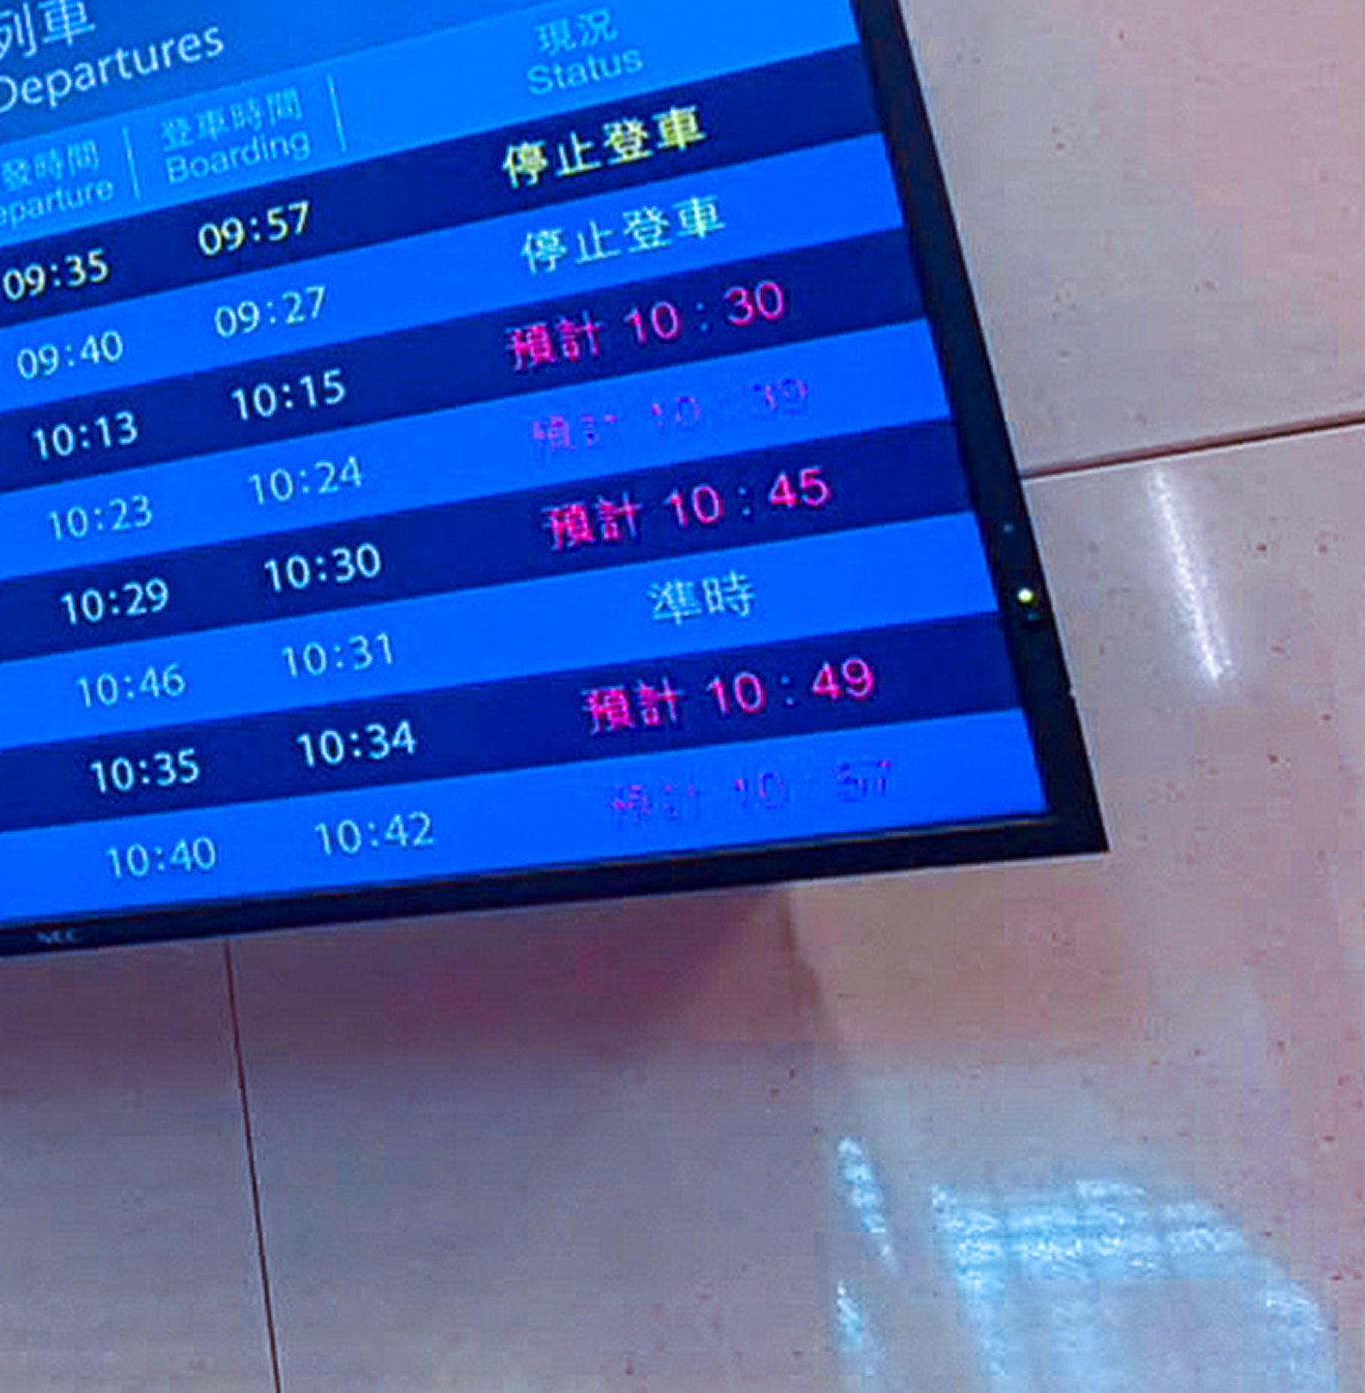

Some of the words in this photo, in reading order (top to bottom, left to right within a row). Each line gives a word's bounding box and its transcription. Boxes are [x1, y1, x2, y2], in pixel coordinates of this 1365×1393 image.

[536, 8, 617, 57] 現況
[526, 47, 643, 96] Status
[162, 87, 304, 152] 登車時間
[167, 130, 310, 184] Boarding
[502, 106, 707, 189] 停止登車
[198, 201, 310, 258] 09:57
[520, 195, 725, 275] 停止登車
[2, 248, 110, 301] 09:35
[215, 286, 326, 339] 09:27
[16, 330, 123, 380] 09:40
[505, 312, 602, 372] 預計
[231, 369, 346, 422] 10:15
[31, 411, 139, 461] 10:13
[248, 456, 363, 506] 10:24
[48, 495, 153, 542] 10:23
[542, 491, 642, 551] 預計
[264, 542, 381, 593] 10:30
[60, 577, 169, 626] 10:29
[648, 571, 756, 625] 準時
[282, 633, 394, 679] 10:31
[76, 664, 186, 709] 10:46
[581, 676, 682, 736] 預計
[297, 720, 417, 769] 10:34
[89, 748, 201, 795] 10:35
[106, 836, 217, 880] 10:40
[314, 811, 435, 857] 10:42
